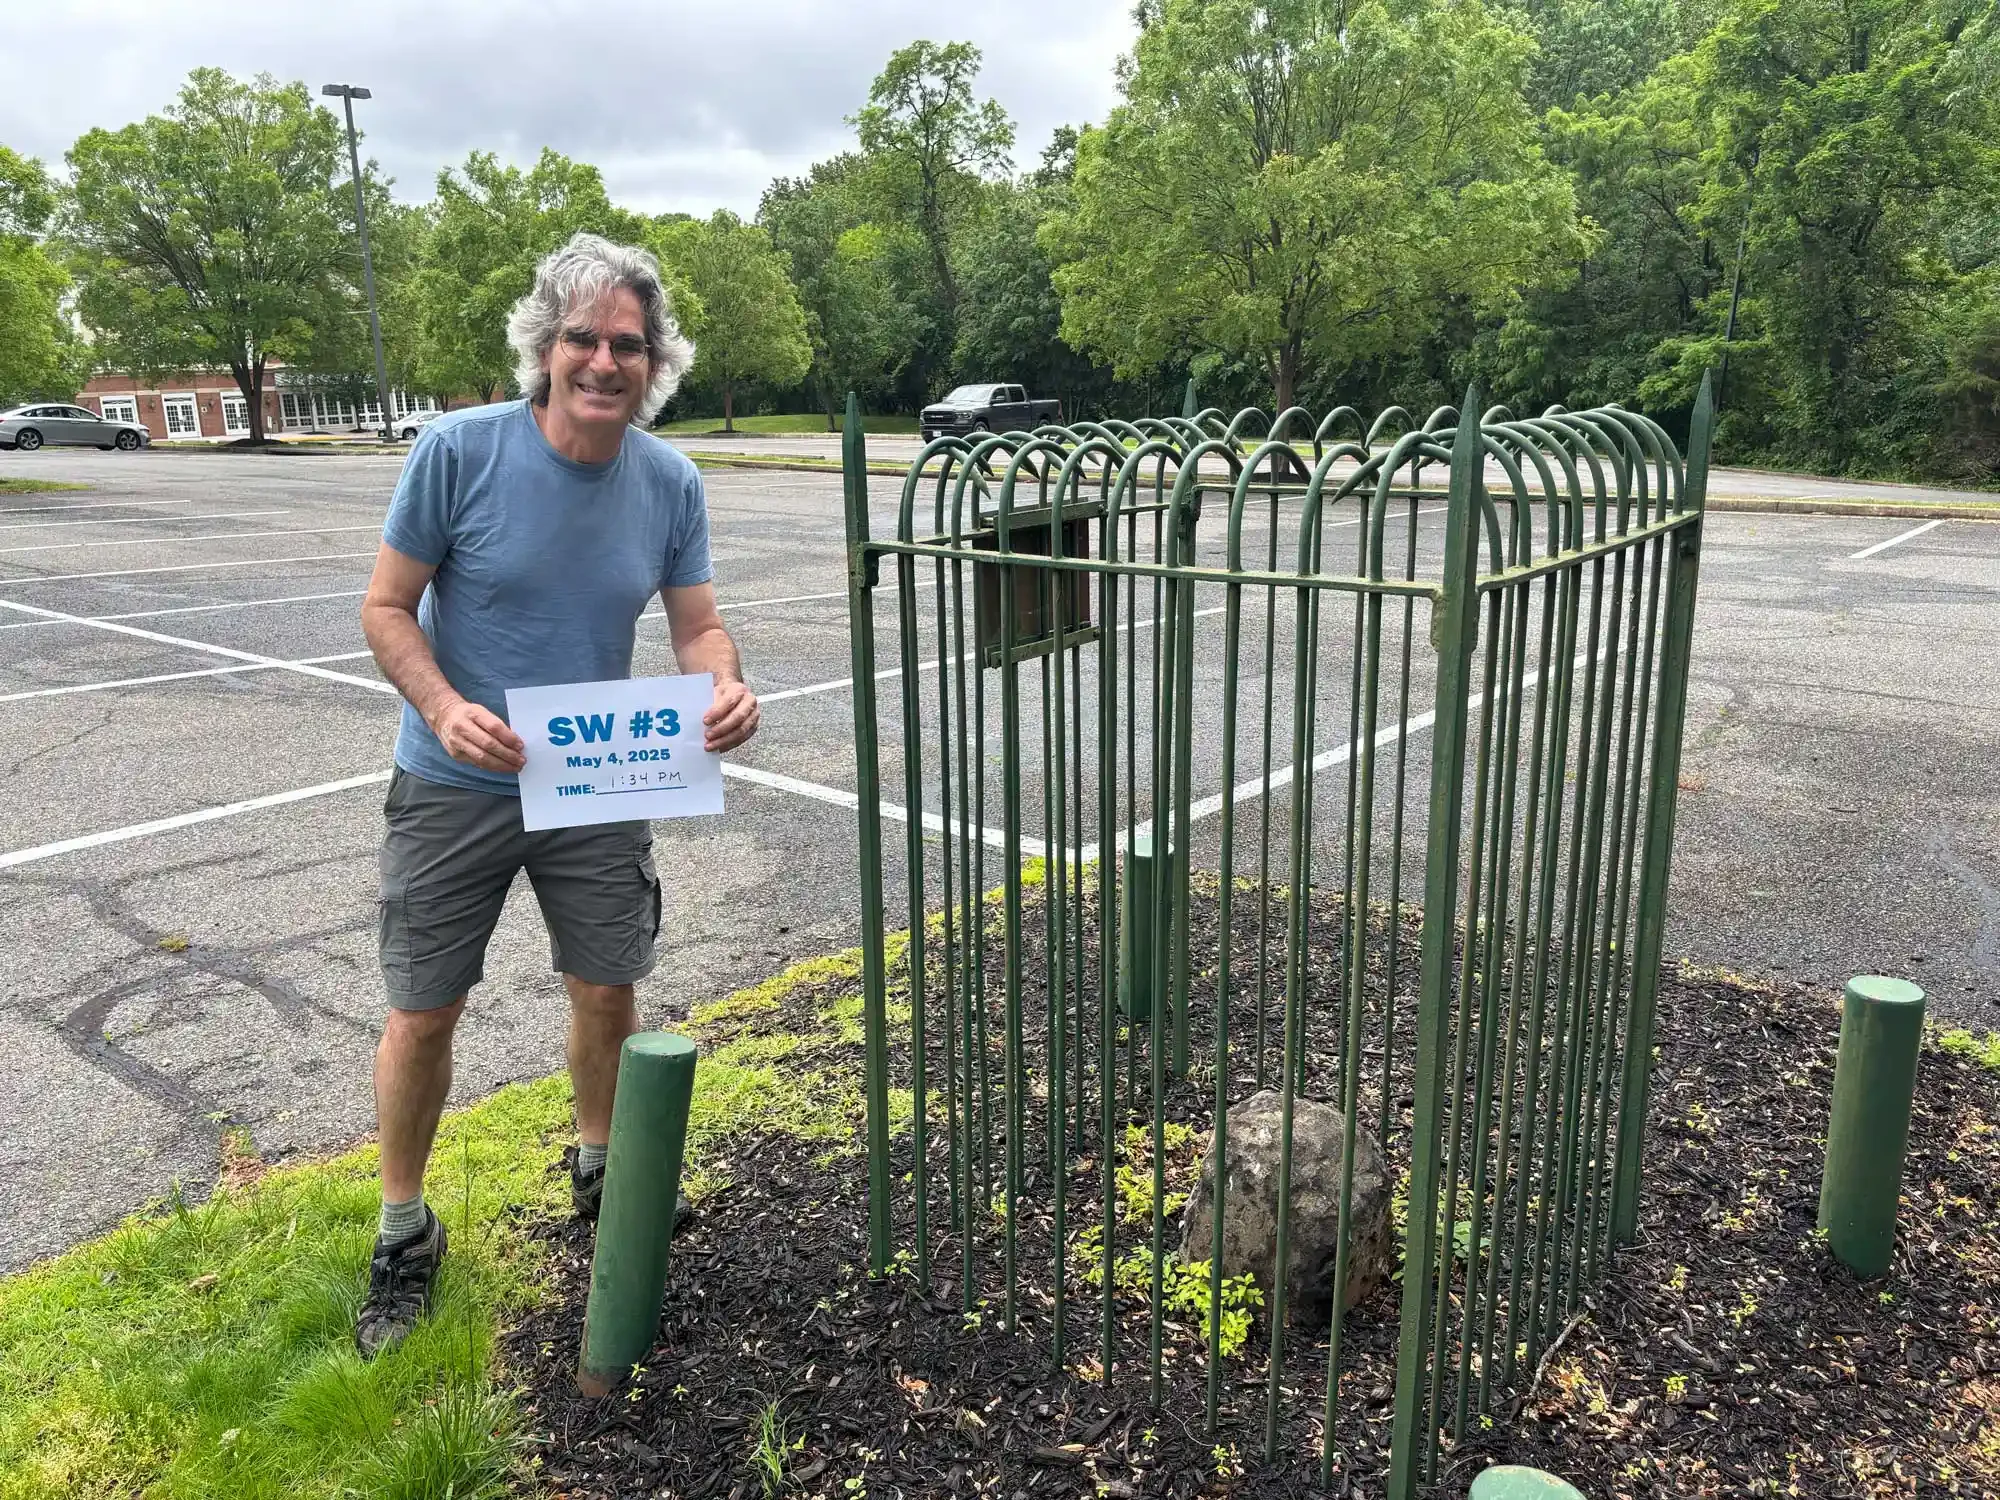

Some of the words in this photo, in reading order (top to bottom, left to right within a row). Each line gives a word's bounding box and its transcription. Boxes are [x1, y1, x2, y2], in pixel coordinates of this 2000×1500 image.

[547, 713, 615, 746] SW
[628, 708, 681, 739] #3
[566, 755, 602, 769] May
[607, 752, 624, 766] 4,
[628, 749, 671, 763] 2025
[611, 772, 649, 788] 1:34
[658, 771, 682, 783] PM
[556, 784, 596, 797] TIME:
